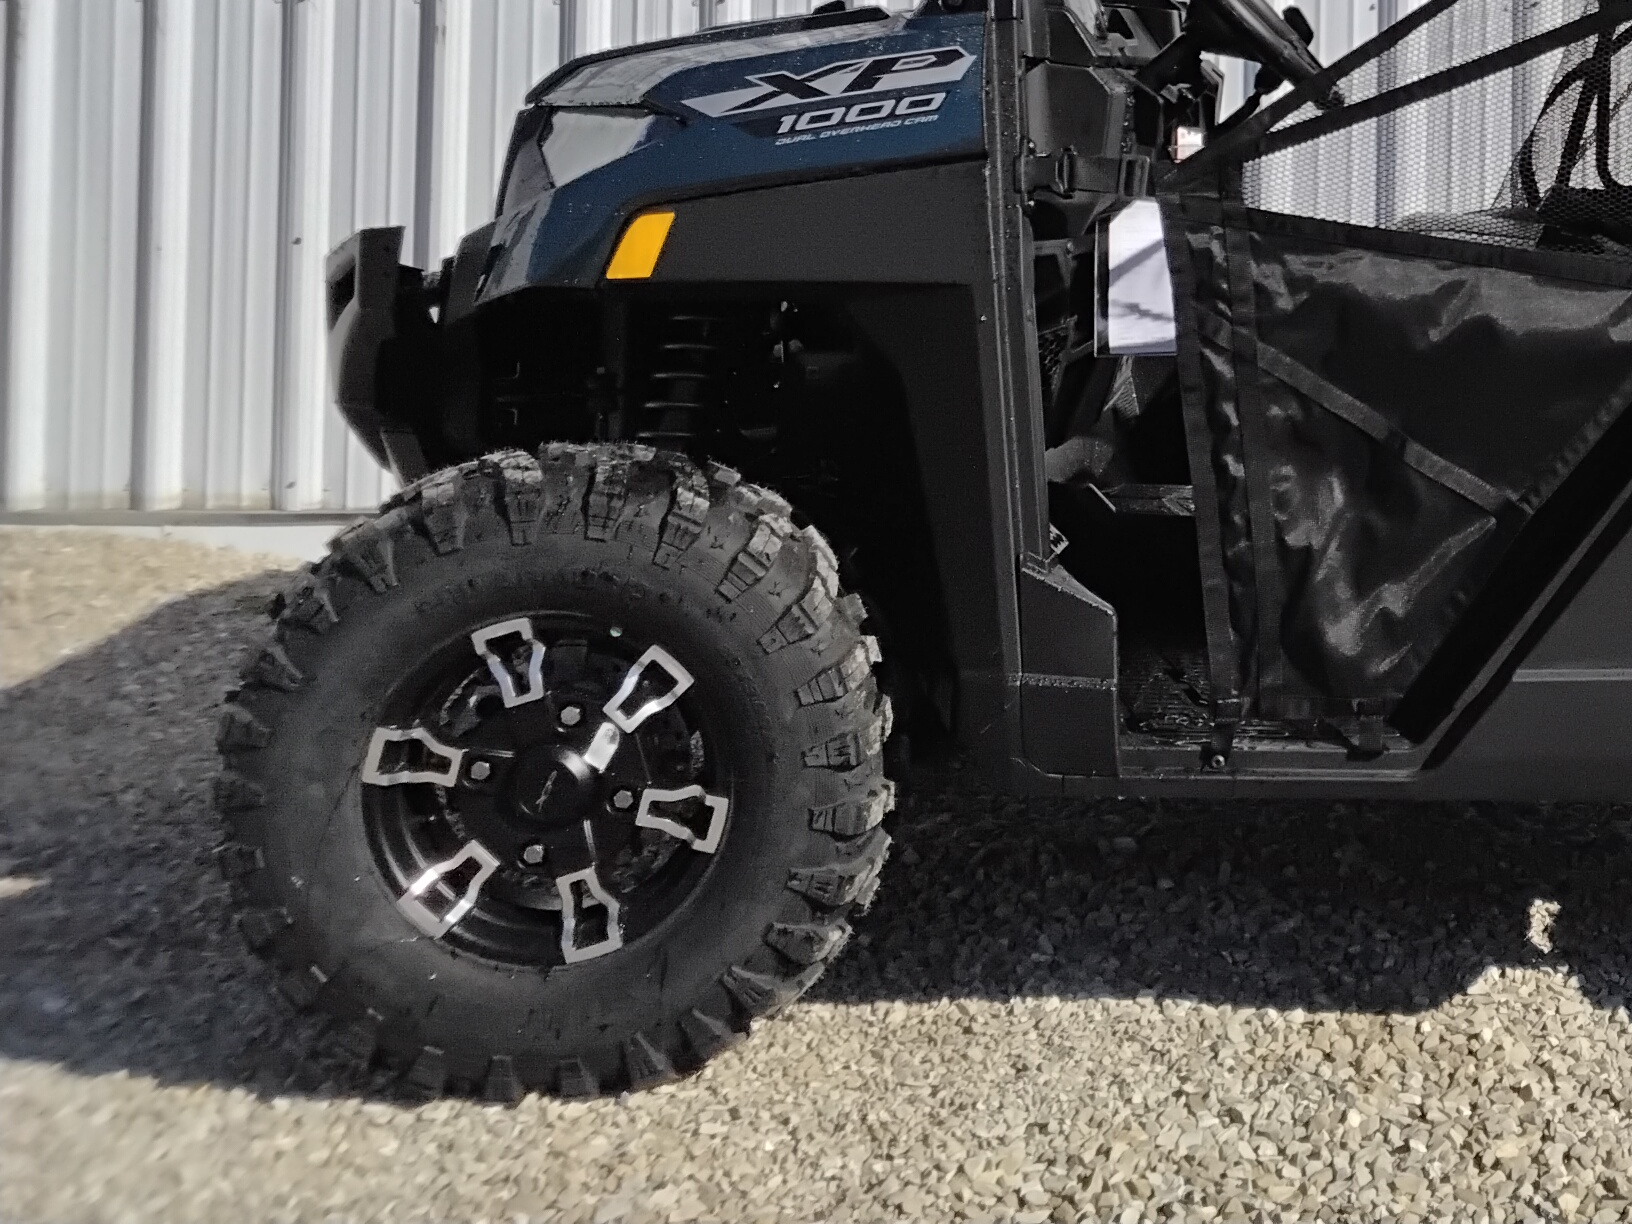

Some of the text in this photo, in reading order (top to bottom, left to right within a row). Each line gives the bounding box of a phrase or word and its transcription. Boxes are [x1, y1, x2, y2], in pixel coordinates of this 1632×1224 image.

[719, 46, 972, 115] XP
[774, 114, 939, 146] DUAL OVERHEAD CAM
[776, 92, 946, 134] 1000
